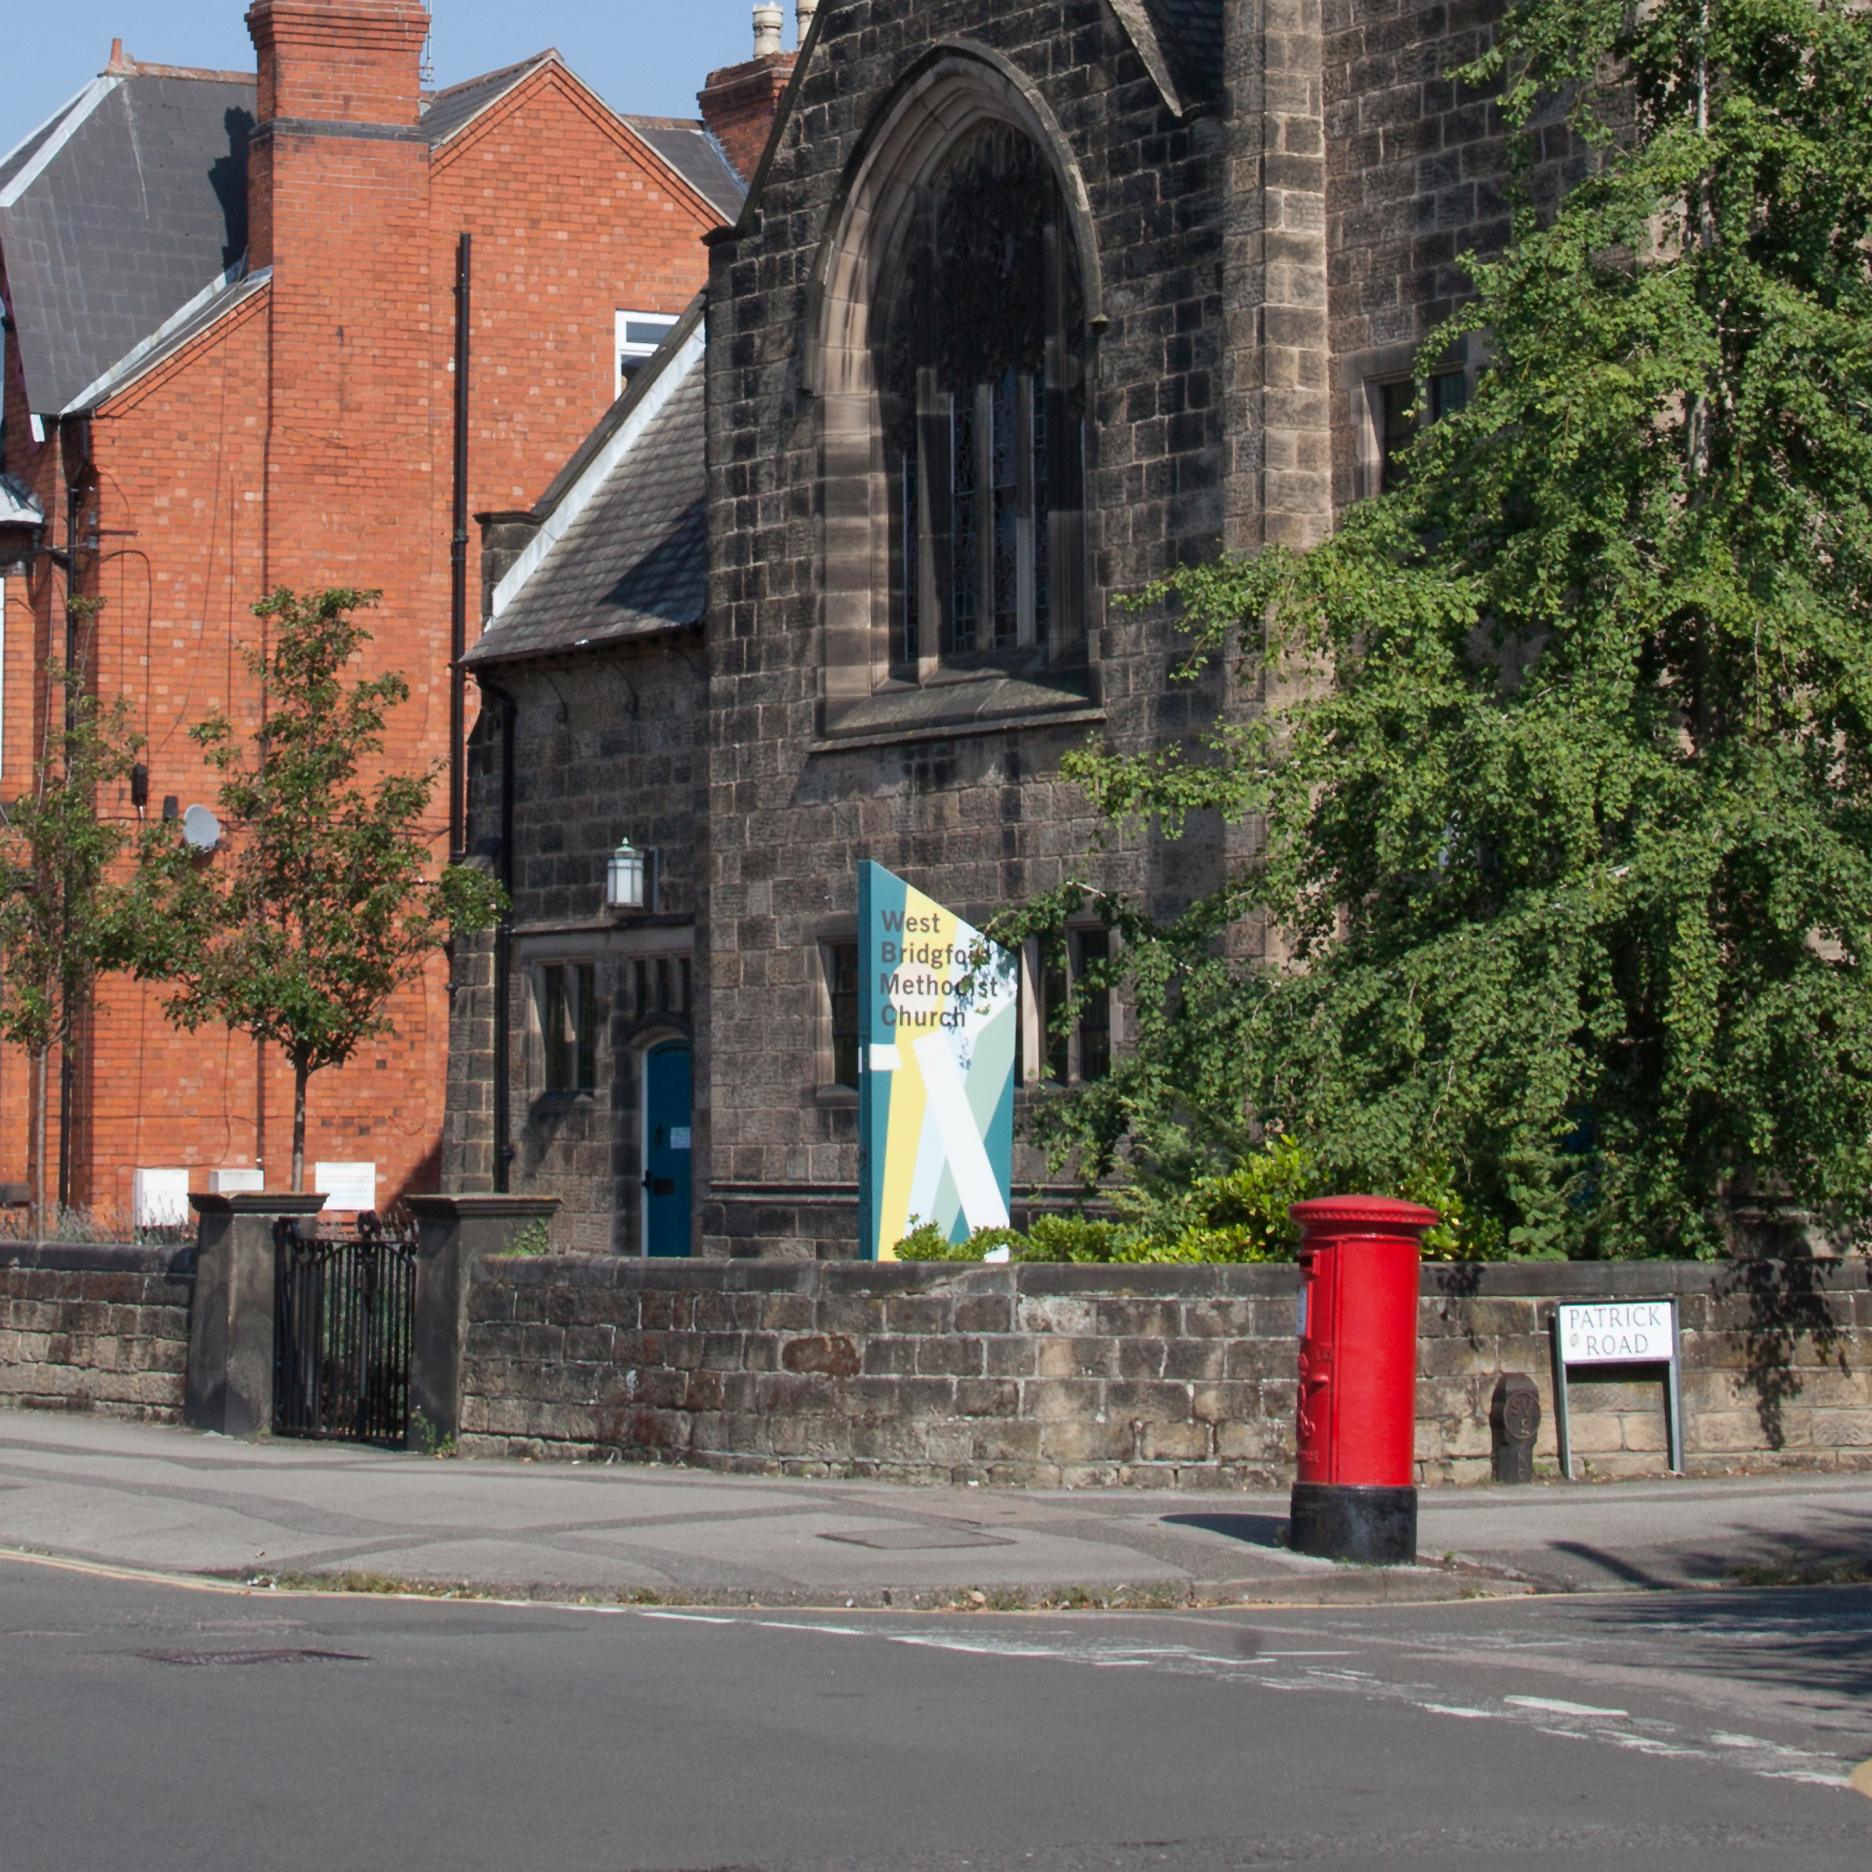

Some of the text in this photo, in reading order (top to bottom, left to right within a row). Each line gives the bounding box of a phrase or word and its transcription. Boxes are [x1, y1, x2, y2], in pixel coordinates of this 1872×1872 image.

[881, 910, 940, 933] West
[881, 941, 991, 969] Bridgfod
[881, 1004, 966, 1027] Church
[1569, 1306, 1662, 1329] PATRICK
[1585, 1333, 1649, 1356] ROAD
